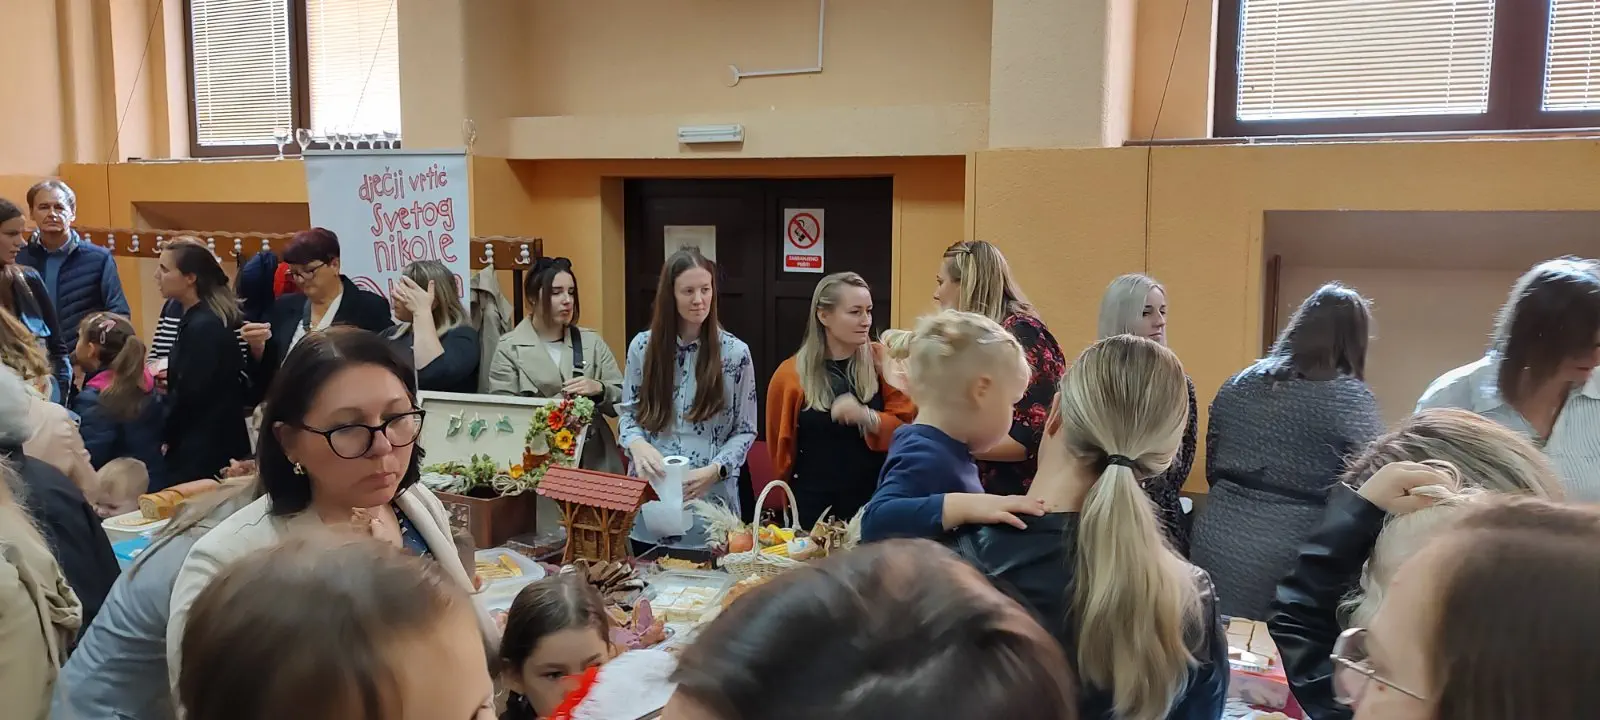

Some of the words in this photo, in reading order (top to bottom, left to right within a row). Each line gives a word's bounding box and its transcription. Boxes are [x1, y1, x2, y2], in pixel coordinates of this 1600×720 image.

[358, 166, 404, 203] dječji
[409, 163, 447, 192] vrtić
[374, 231, 457, 272] nikole
